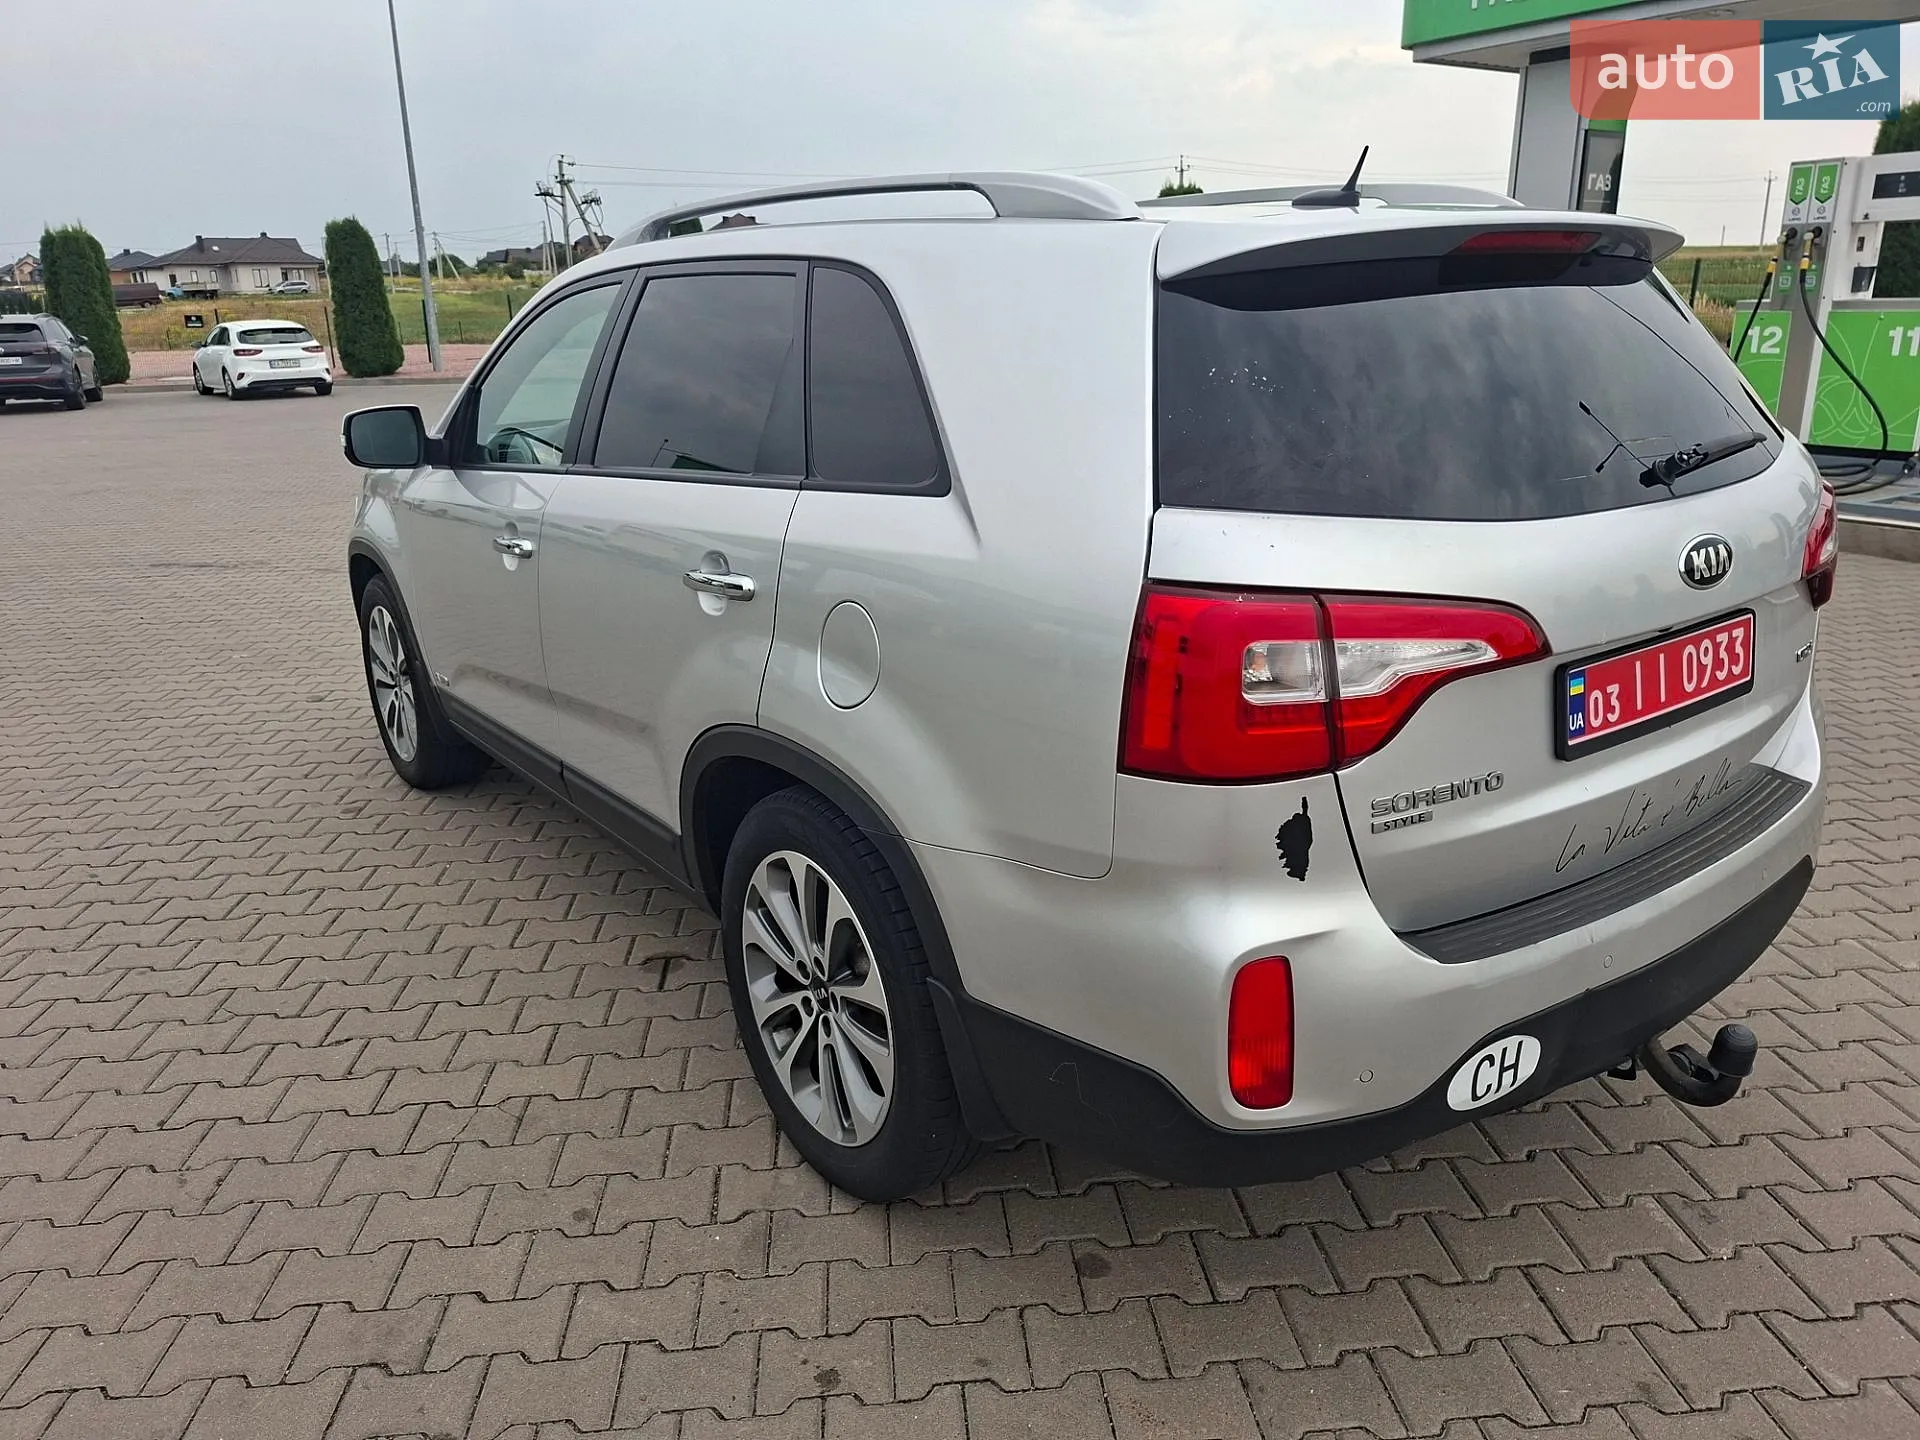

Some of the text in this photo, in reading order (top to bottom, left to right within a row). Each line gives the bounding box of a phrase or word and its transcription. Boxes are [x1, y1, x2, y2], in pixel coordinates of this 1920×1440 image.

[1587, 172, 1612, 192] ГАЗ
[1795, 177, 1805, 196] ГАЗ
[1820, 175, 1831, 194] ГАЗ
[1747, 325, 1783, 355] 12
[1888, 326, 1920, 356] 11
[1690, 543, 1730, 580] KIA
[1589, 683, 1621, 729] 03
[1682, 627, 1745, 694] 0933
[1569, 714, 1584, 731] UA
[1371, 769, 1505, 818] SORENTO
[1383, 812, 1426, 831] STYLE
[1554, 823, 1586, 874] La
[1604, 788, 1654, 855] Vita
[813, 987, 828, 1000] KIA
[1471, 1040, 1524, 1102] CH
